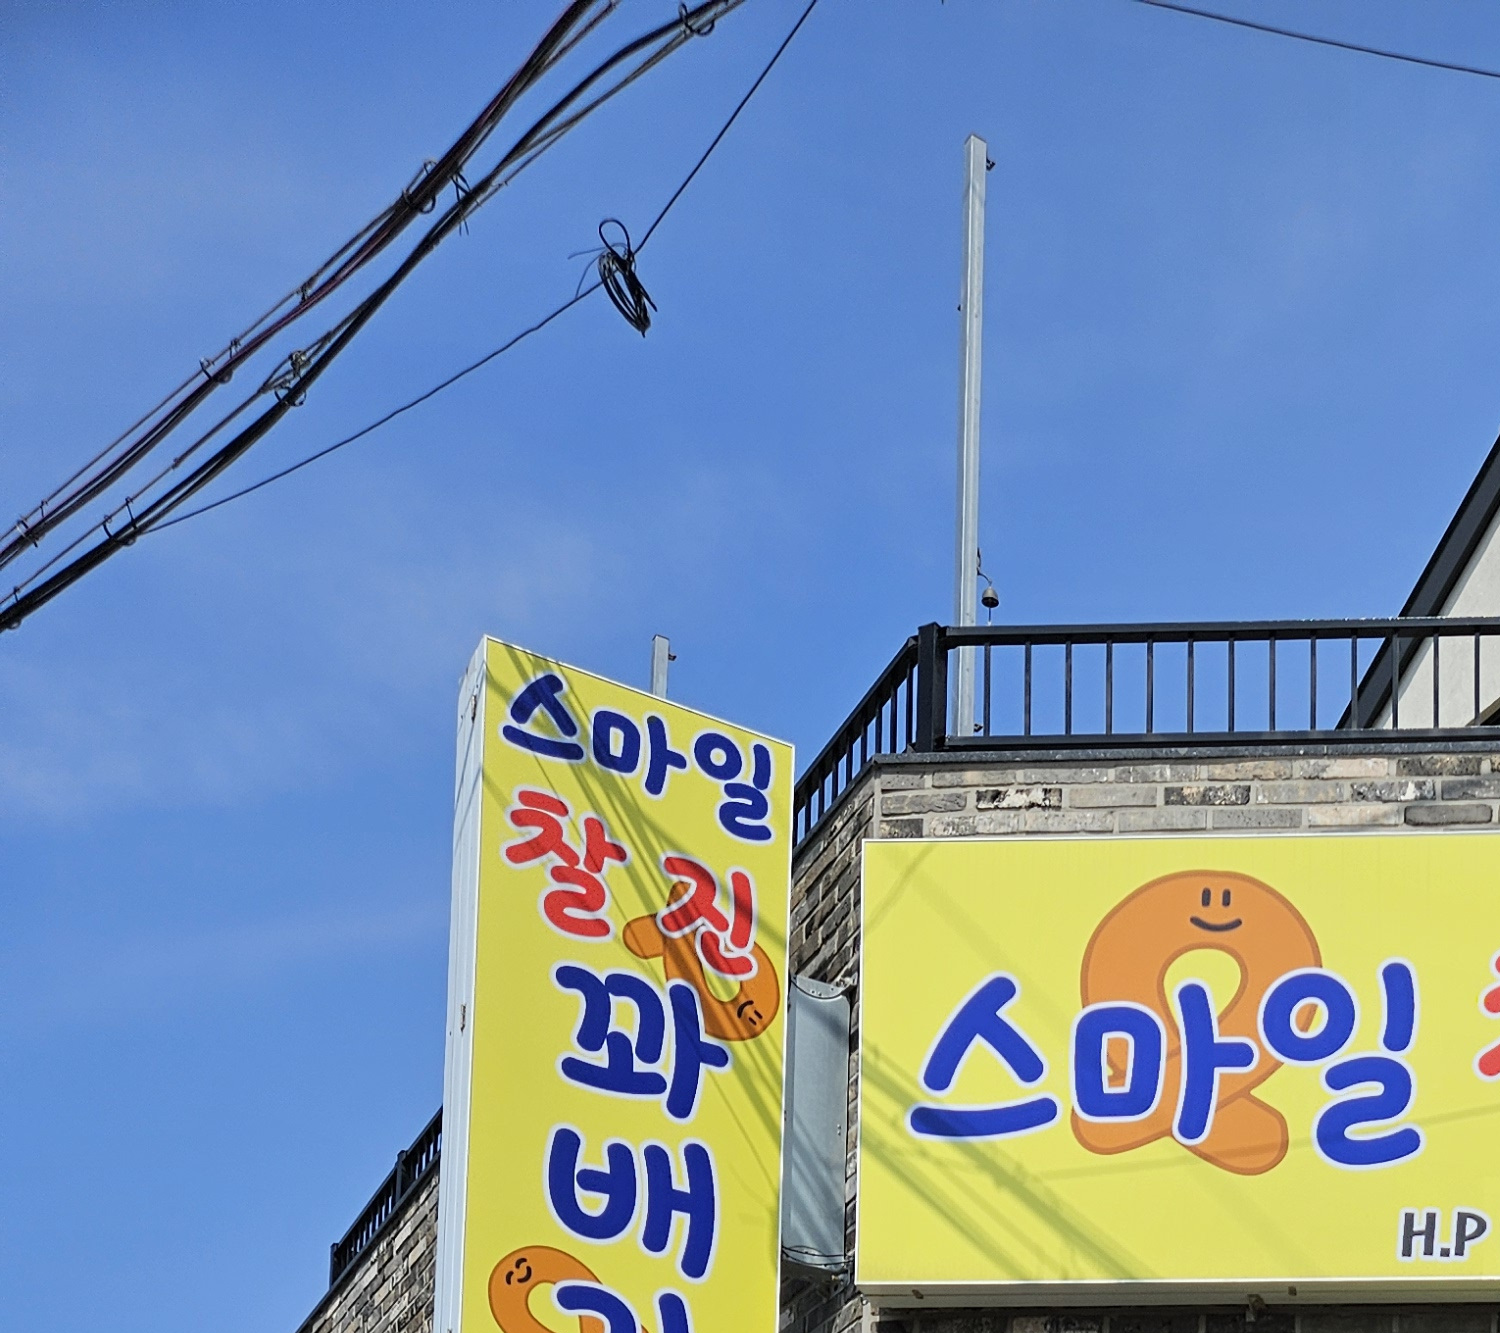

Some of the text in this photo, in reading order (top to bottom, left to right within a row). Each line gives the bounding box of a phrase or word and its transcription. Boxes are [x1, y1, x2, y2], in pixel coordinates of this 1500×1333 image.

[502, 674, 772, 841] 스마일
[505, 790, 754, 976] 찰진
[910, 963, 1421, 1165] 스마일
[1401, 1211, 1487, 1258] H.P
